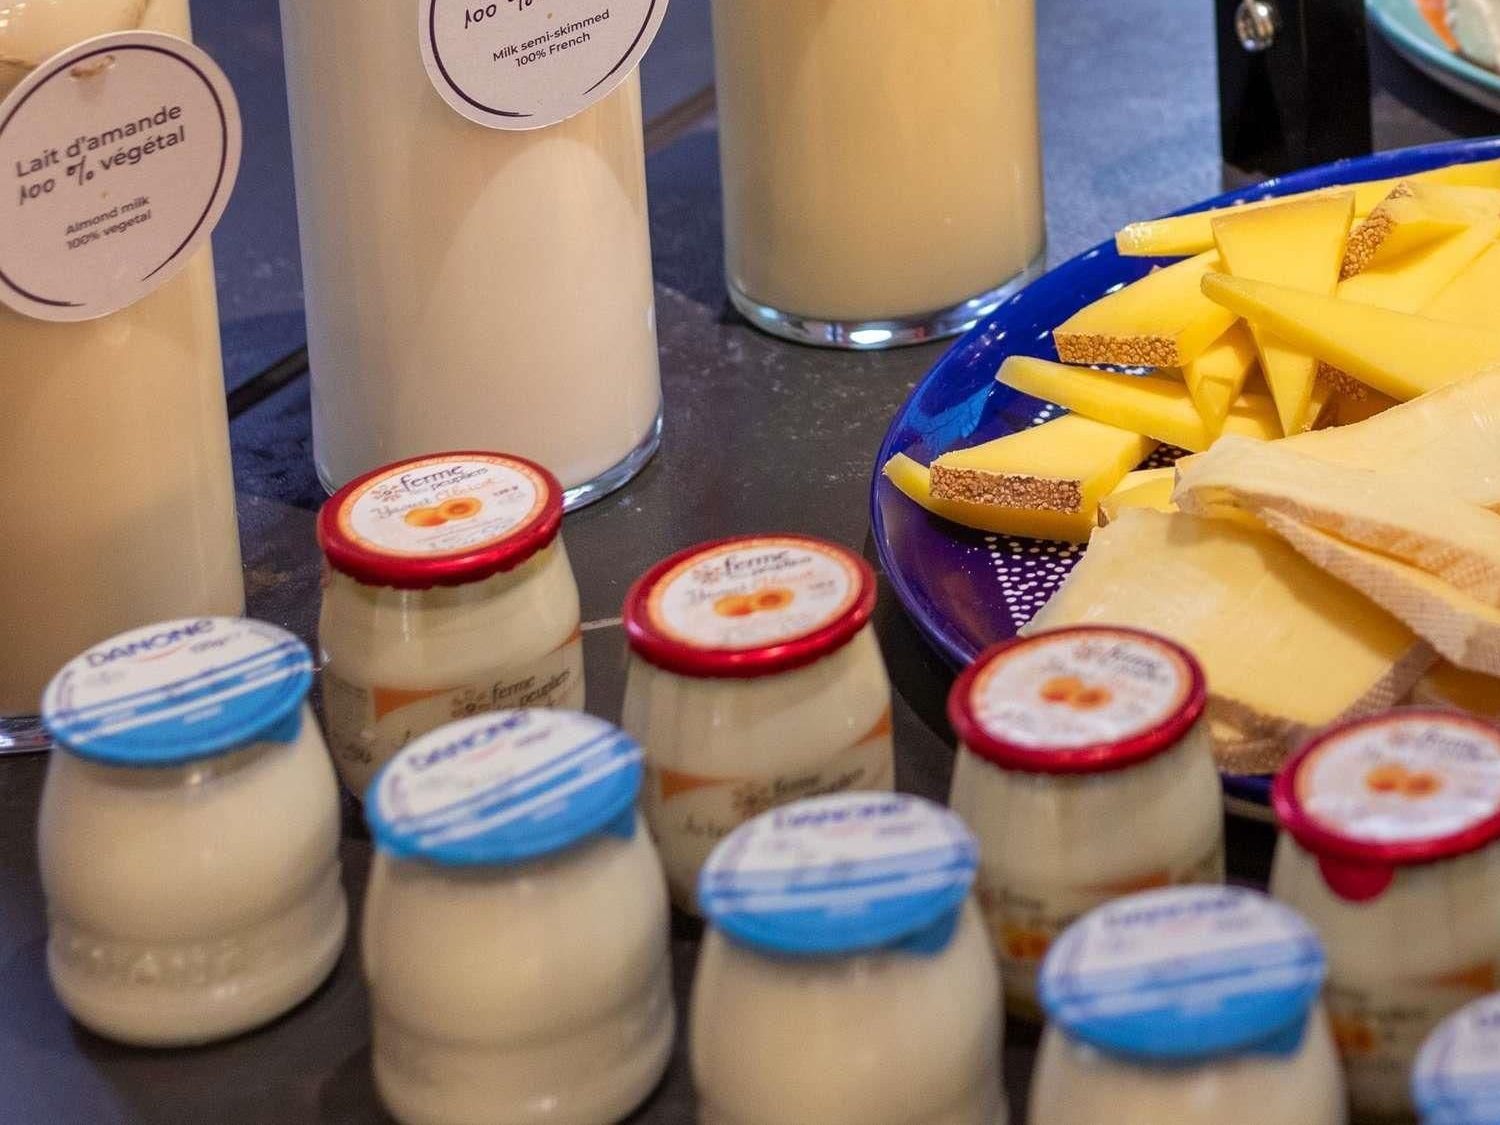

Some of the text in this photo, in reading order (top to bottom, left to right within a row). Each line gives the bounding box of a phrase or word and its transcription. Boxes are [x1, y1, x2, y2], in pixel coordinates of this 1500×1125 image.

[493, 10, 610, 61] Milk semi-skimmed
[515, 32, 590, 67] 100% French
[15, 104, 182, 178] Lait d'amande
[100, 126, 185, 171] végétal
[65, 196, 150, 236] Almond milk
[66, 210, 152, 250] 100% vegetal
[401, 465, 464, 492] ferme
[85, 619, 214, 668] DANONE
